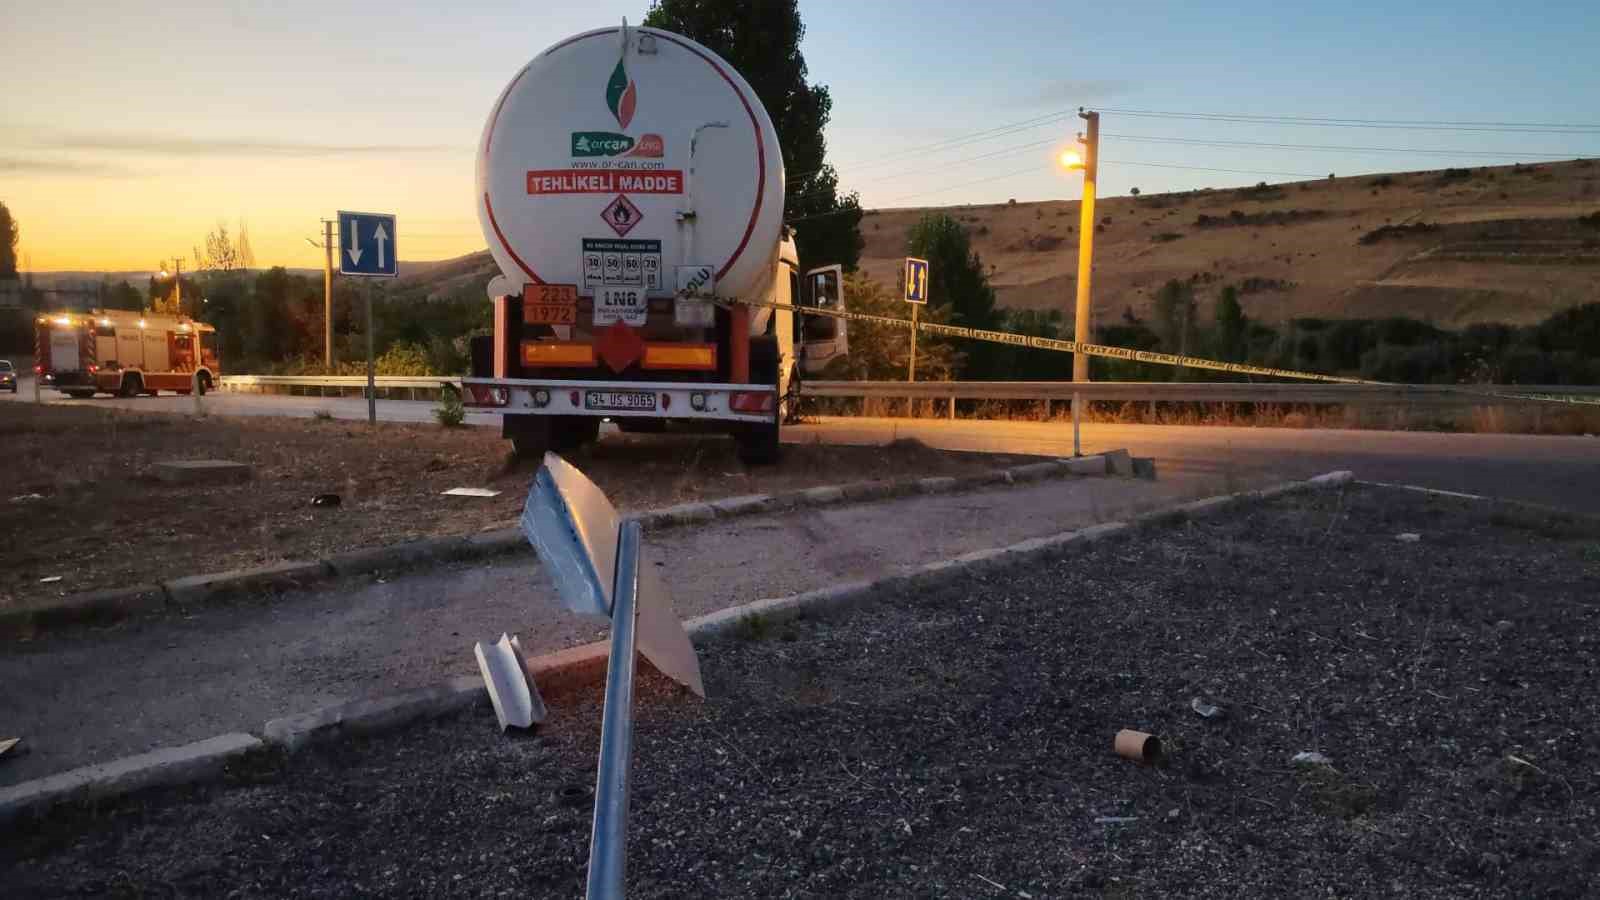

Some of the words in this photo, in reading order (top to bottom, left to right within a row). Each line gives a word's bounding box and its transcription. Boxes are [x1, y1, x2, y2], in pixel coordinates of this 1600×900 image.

[571, 160, 665, 170] www.or-can.com
[532, 173, 613, 191] TEHLİKELİ
[619, 176, 677, 191] MADDE
[607, 259, 618, 268] 50
[541, 287, 571, 300] 223
[604, 291, 637, 306] LNG
[532, 306, 571, 321] 1972
